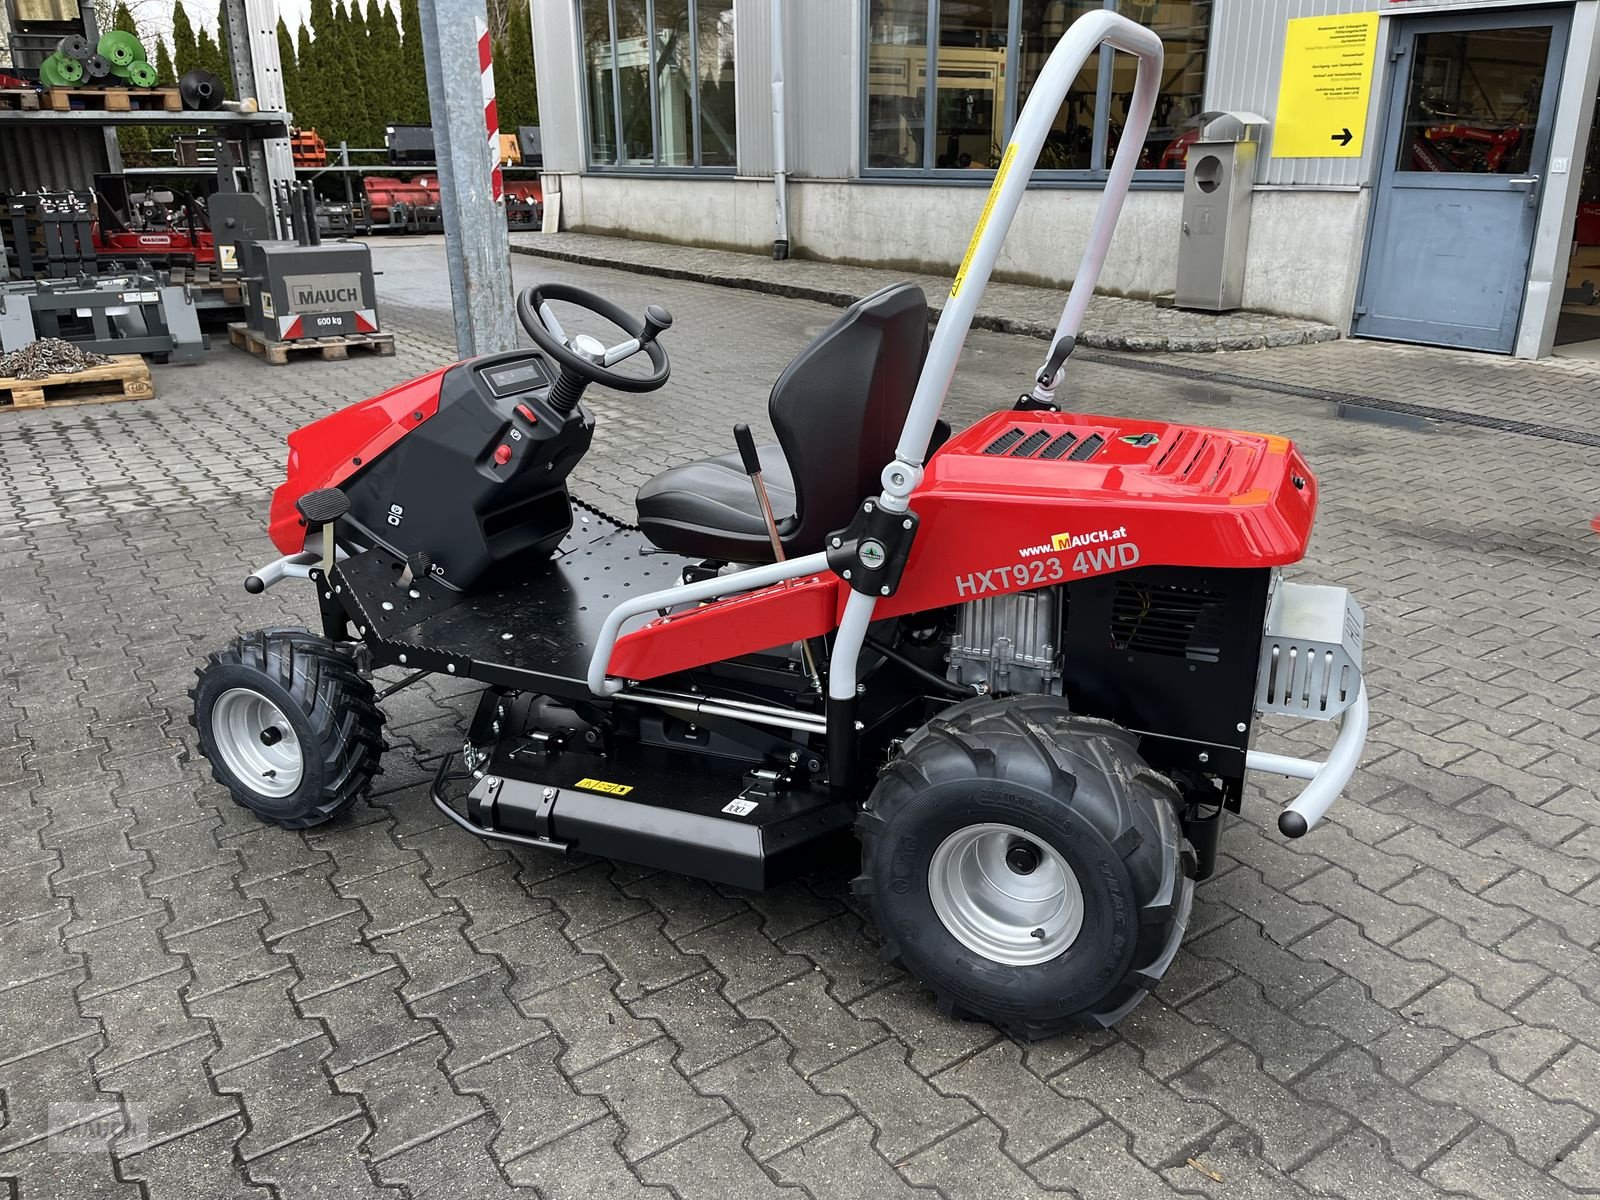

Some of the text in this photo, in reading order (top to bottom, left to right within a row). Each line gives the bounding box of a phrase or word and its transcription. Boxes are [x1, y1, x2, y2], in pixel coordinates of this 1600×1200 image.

[298, 287, 358, 305] MAUCH
[316, 316, 343, 326] 600 kg
[1018, 526, 1128, 558] www.MAUCH.at
[955, 542, 1140, 597] HXT923 4WD
